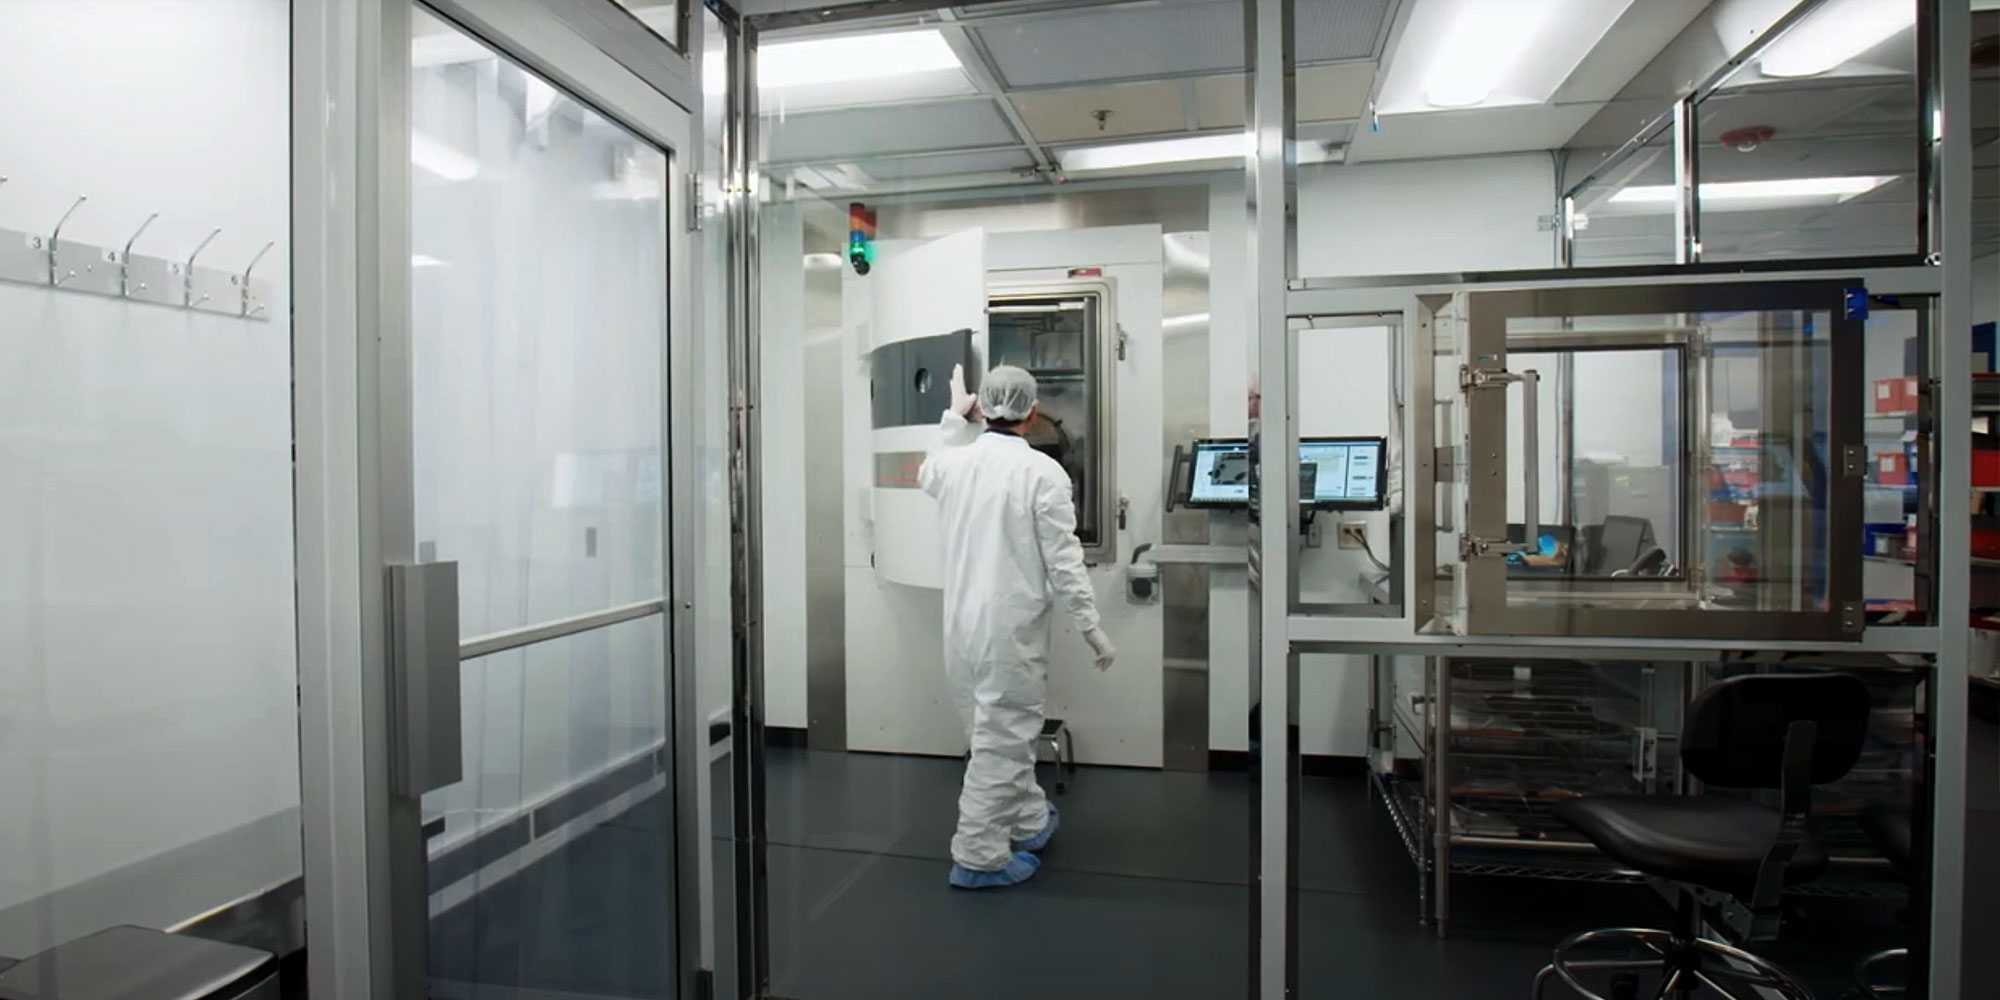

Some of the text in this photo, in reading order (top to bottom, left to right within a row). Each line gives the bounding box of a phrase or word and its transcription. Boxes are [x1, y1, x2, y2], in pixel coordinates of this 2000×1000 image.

[33, 236, 42, 249] 3
[107, 251, 116, 262] 4
[172, 263, 180, 275] 5
[230, 274, 239, 286] 6
